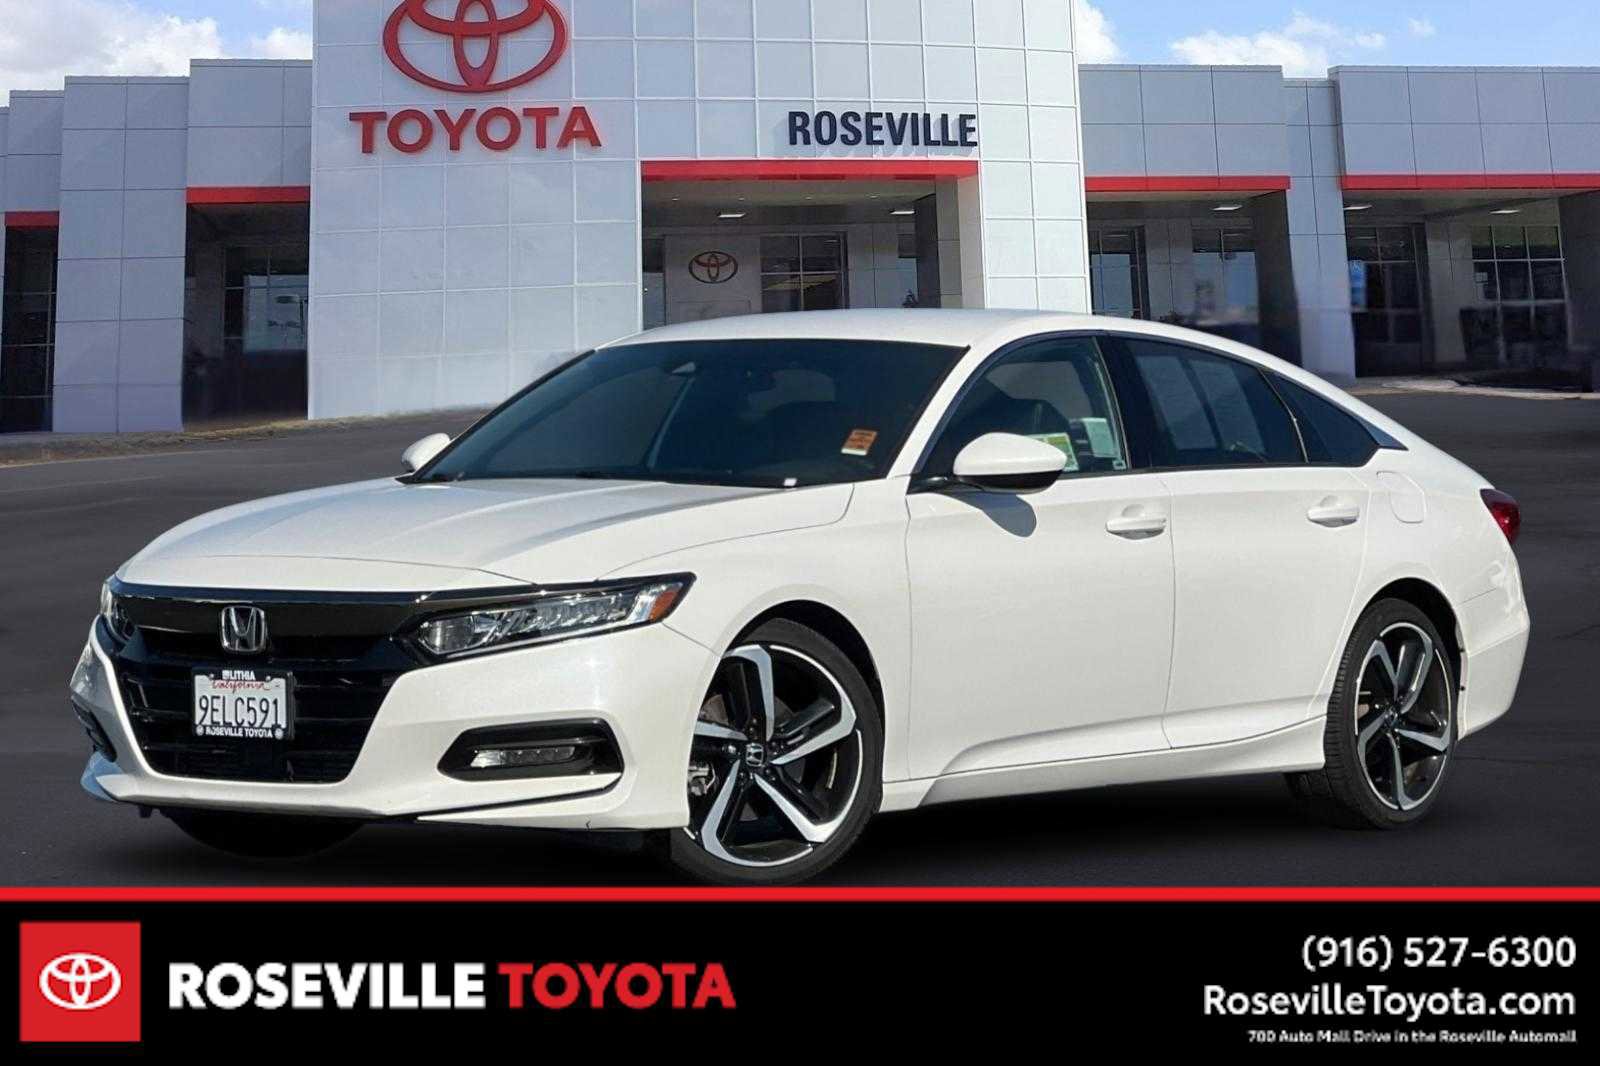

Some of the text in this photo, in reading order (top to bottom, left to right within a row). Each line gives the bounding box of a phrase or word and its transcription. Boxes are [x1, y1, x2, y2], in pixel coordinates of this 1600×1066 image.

[349, 106, 602, 154] TOYOTA
[788, 110, 978, 147] ROSEVILLE
[230, 670, 256, 681] LITHIA
[199, 695, 279, 728] 9ELC591
[205, 727, 273, 739] ROSEVILLE TOYOTA
